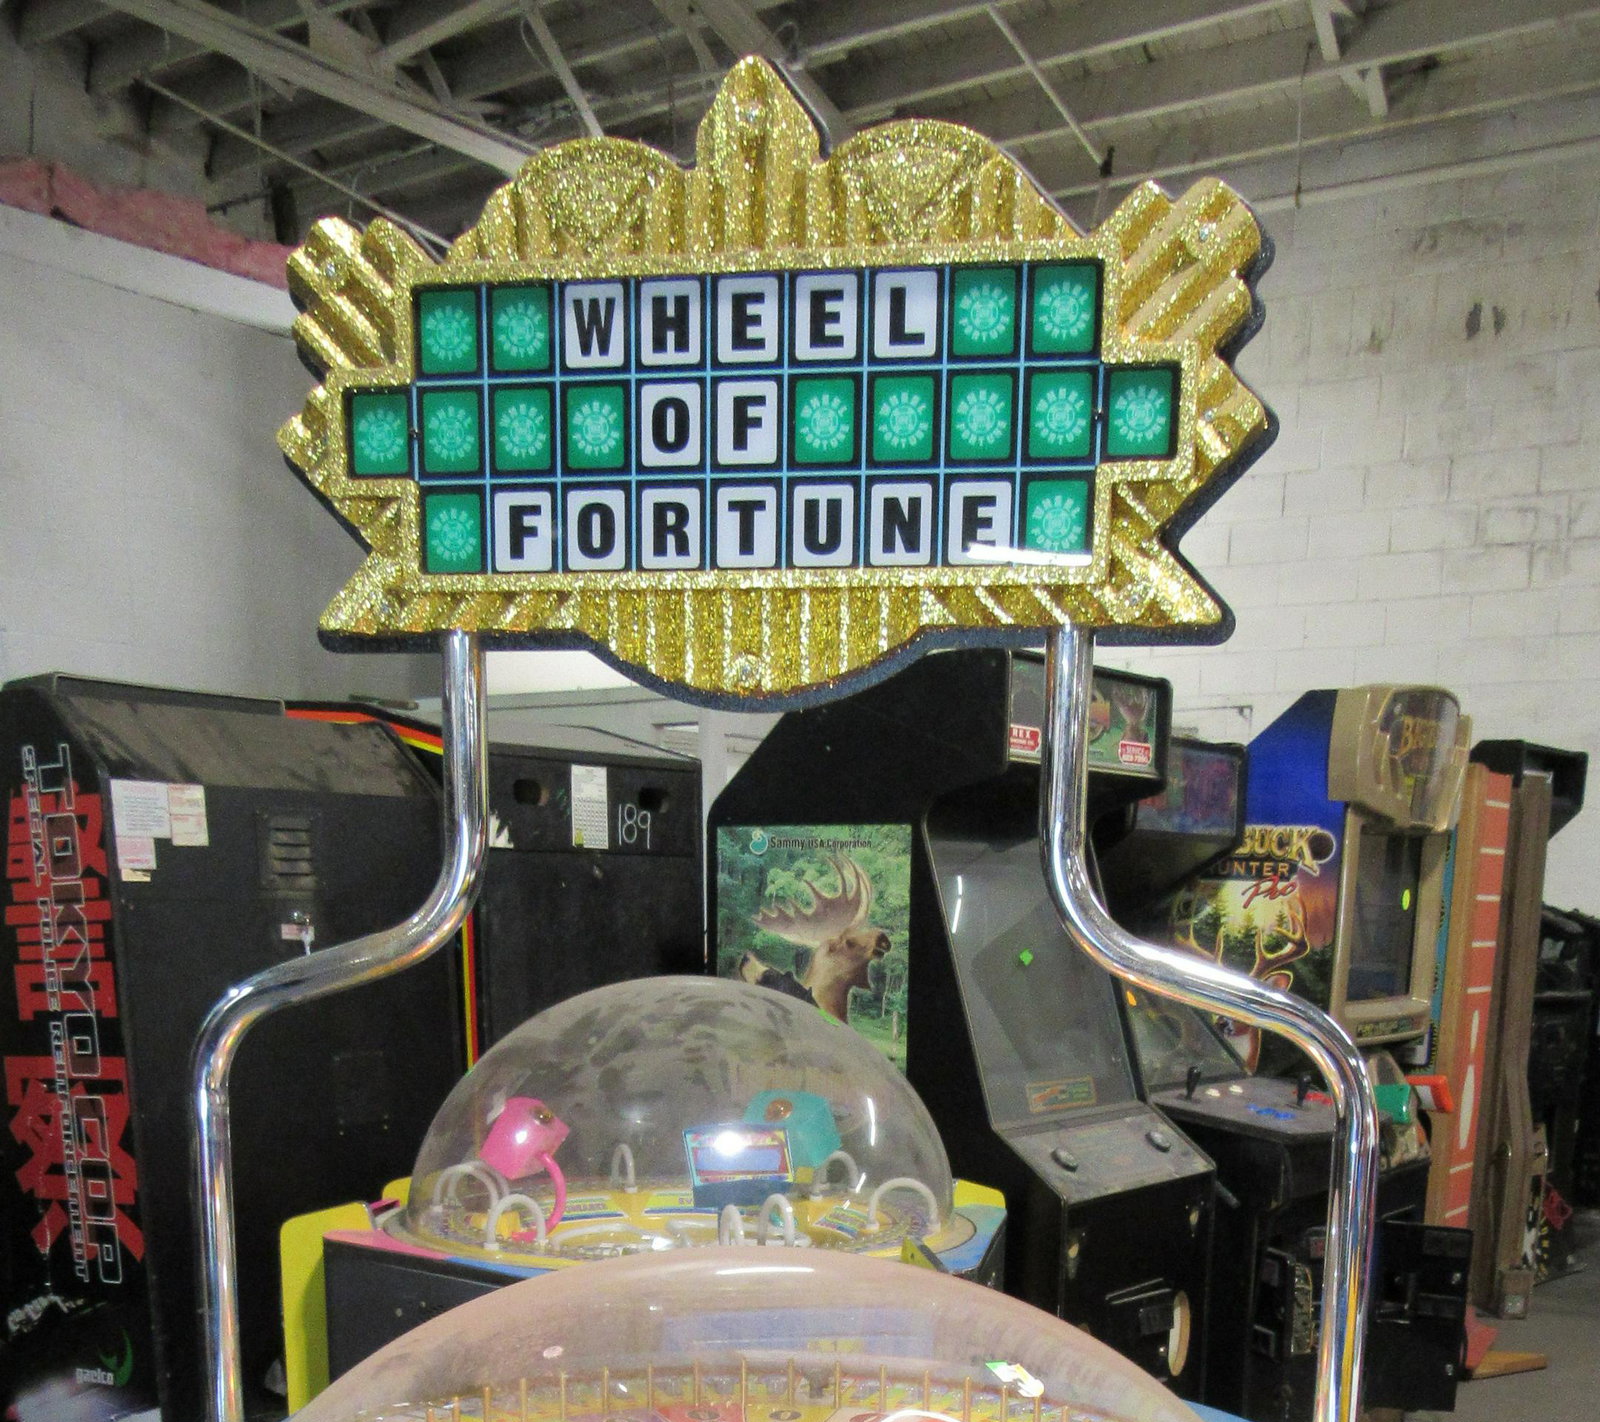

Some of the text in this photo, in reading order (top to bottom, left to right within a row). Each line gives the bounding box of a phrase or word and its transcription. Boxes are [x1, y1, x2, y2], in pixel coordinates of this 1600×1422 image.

[573, 285, 925, 356] WHEEL
[652, 395, 766, 453] OF
[509, 495, 998, 560] FORTUNE
[618, 803, 651, 849] 189
[770, 837, 872, 850] Sammy USA Corporation
[1218, 860, 1290, 876] UNTER
[1241, 874, 1297, 909] Pro
[73, 1096, 122, 1283] COP
